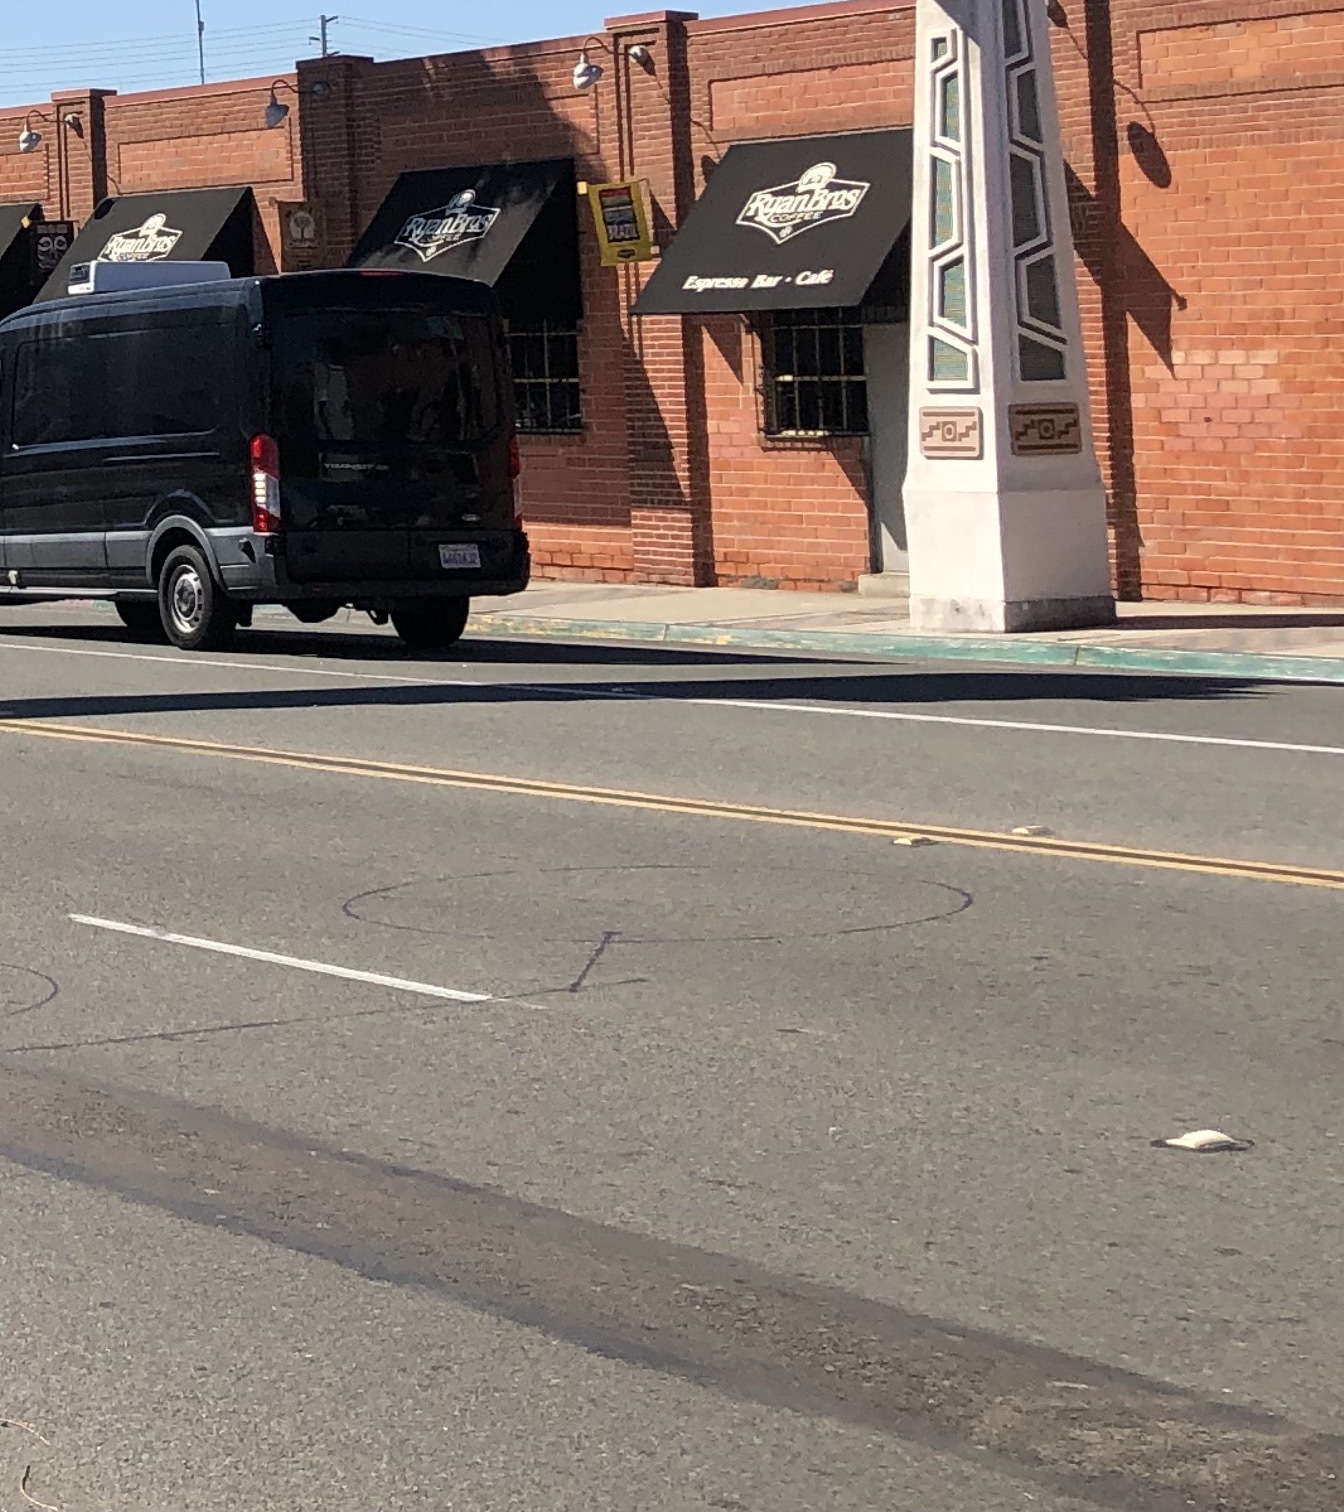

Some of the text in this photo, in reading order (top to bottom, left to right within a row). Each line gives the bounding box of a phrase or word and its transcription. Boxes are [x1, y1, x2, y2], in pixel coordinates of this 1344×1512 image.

[809, 188, 861, 210] Bros
[682, 275, 749, 292] Espresso
[750, 274, 783, 288] Bar
